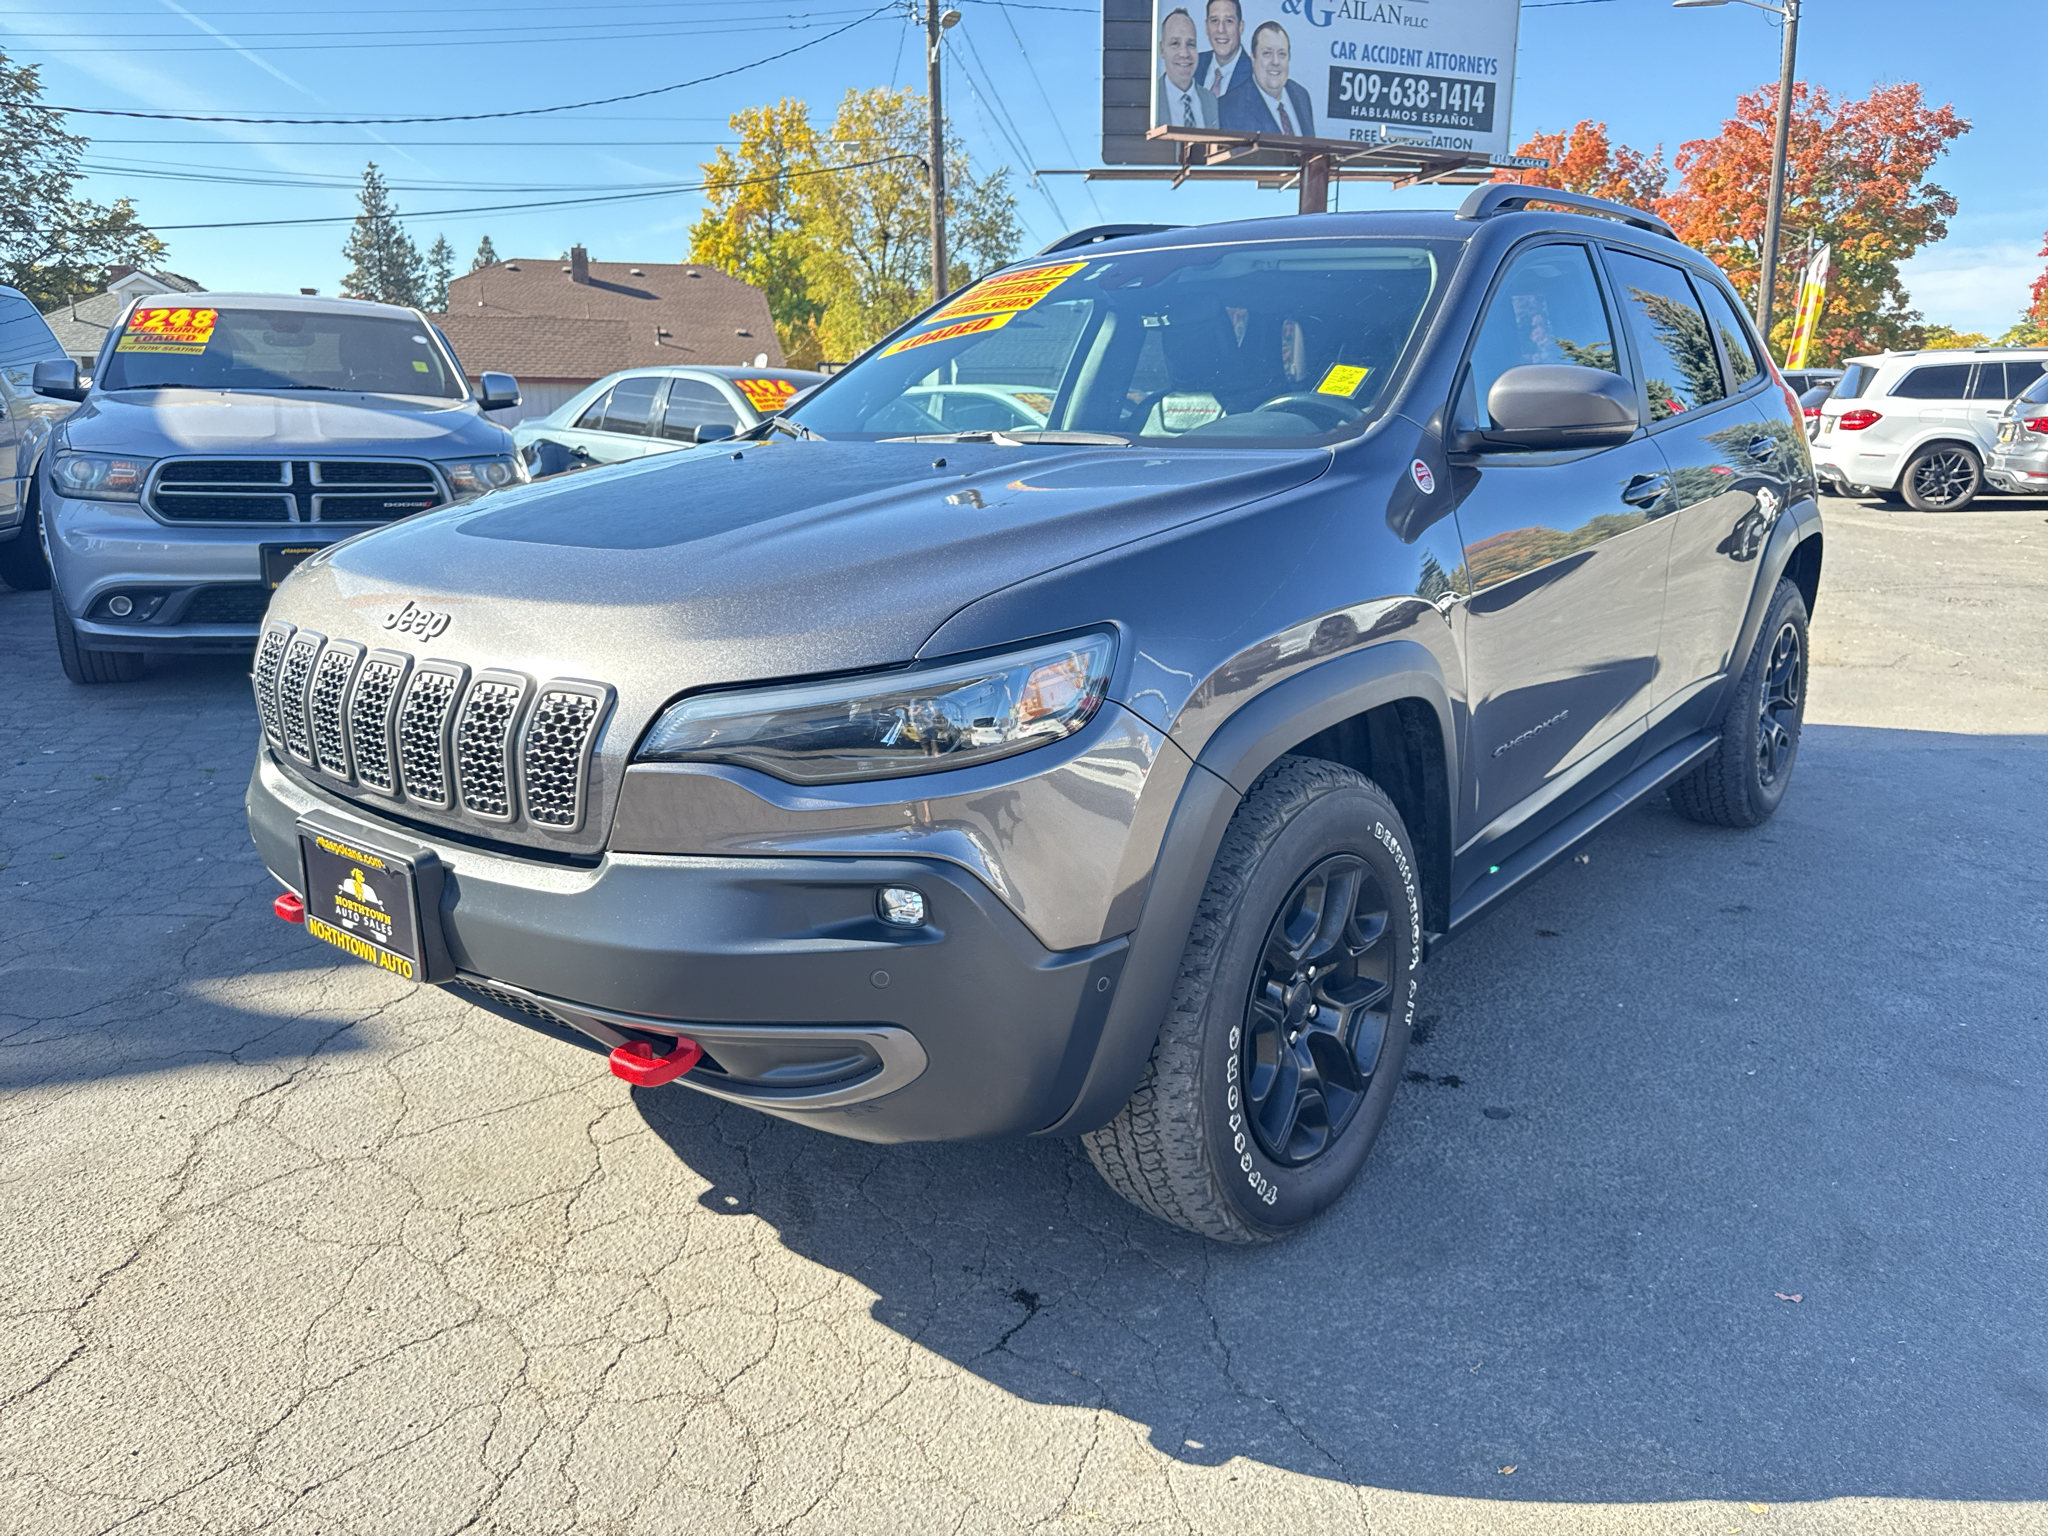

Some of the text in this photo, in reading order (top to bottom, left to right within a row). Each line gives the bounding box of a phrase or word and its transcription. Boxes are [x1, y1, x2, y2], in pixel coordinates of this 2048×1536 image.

[1304, 0, 1403, 27] GAILAN
[1404, 16, 1429, 28] PLLC
[1331, 41, 1498, 75] CAR ACCIDENT ATTORNEYS
[1339, 71, 1485, 114] 509-638-1414
[1351, 105, 1475, 127] HABLAMOS ESPAÑOL
[1349, 128, 1377, 142] FREE
[134, 309, 215, 328] $248
[984, 296, 1041, 311] SEATS
[133, 335, 197, 343] LOADED
[897, 317, 996, 351] LOADED
[382, 600, 452, 643] Jeep
[1491, 709, 1569, 758] CHEROKEE
[334, 895, 392, 925] NORTHTOWN
[1374, 821, 1420, 970] DESTINATION
[335, 905, 393, 936] AUTO SALES
[309, 918, 413, 979] NORTHTOWN AUTO
